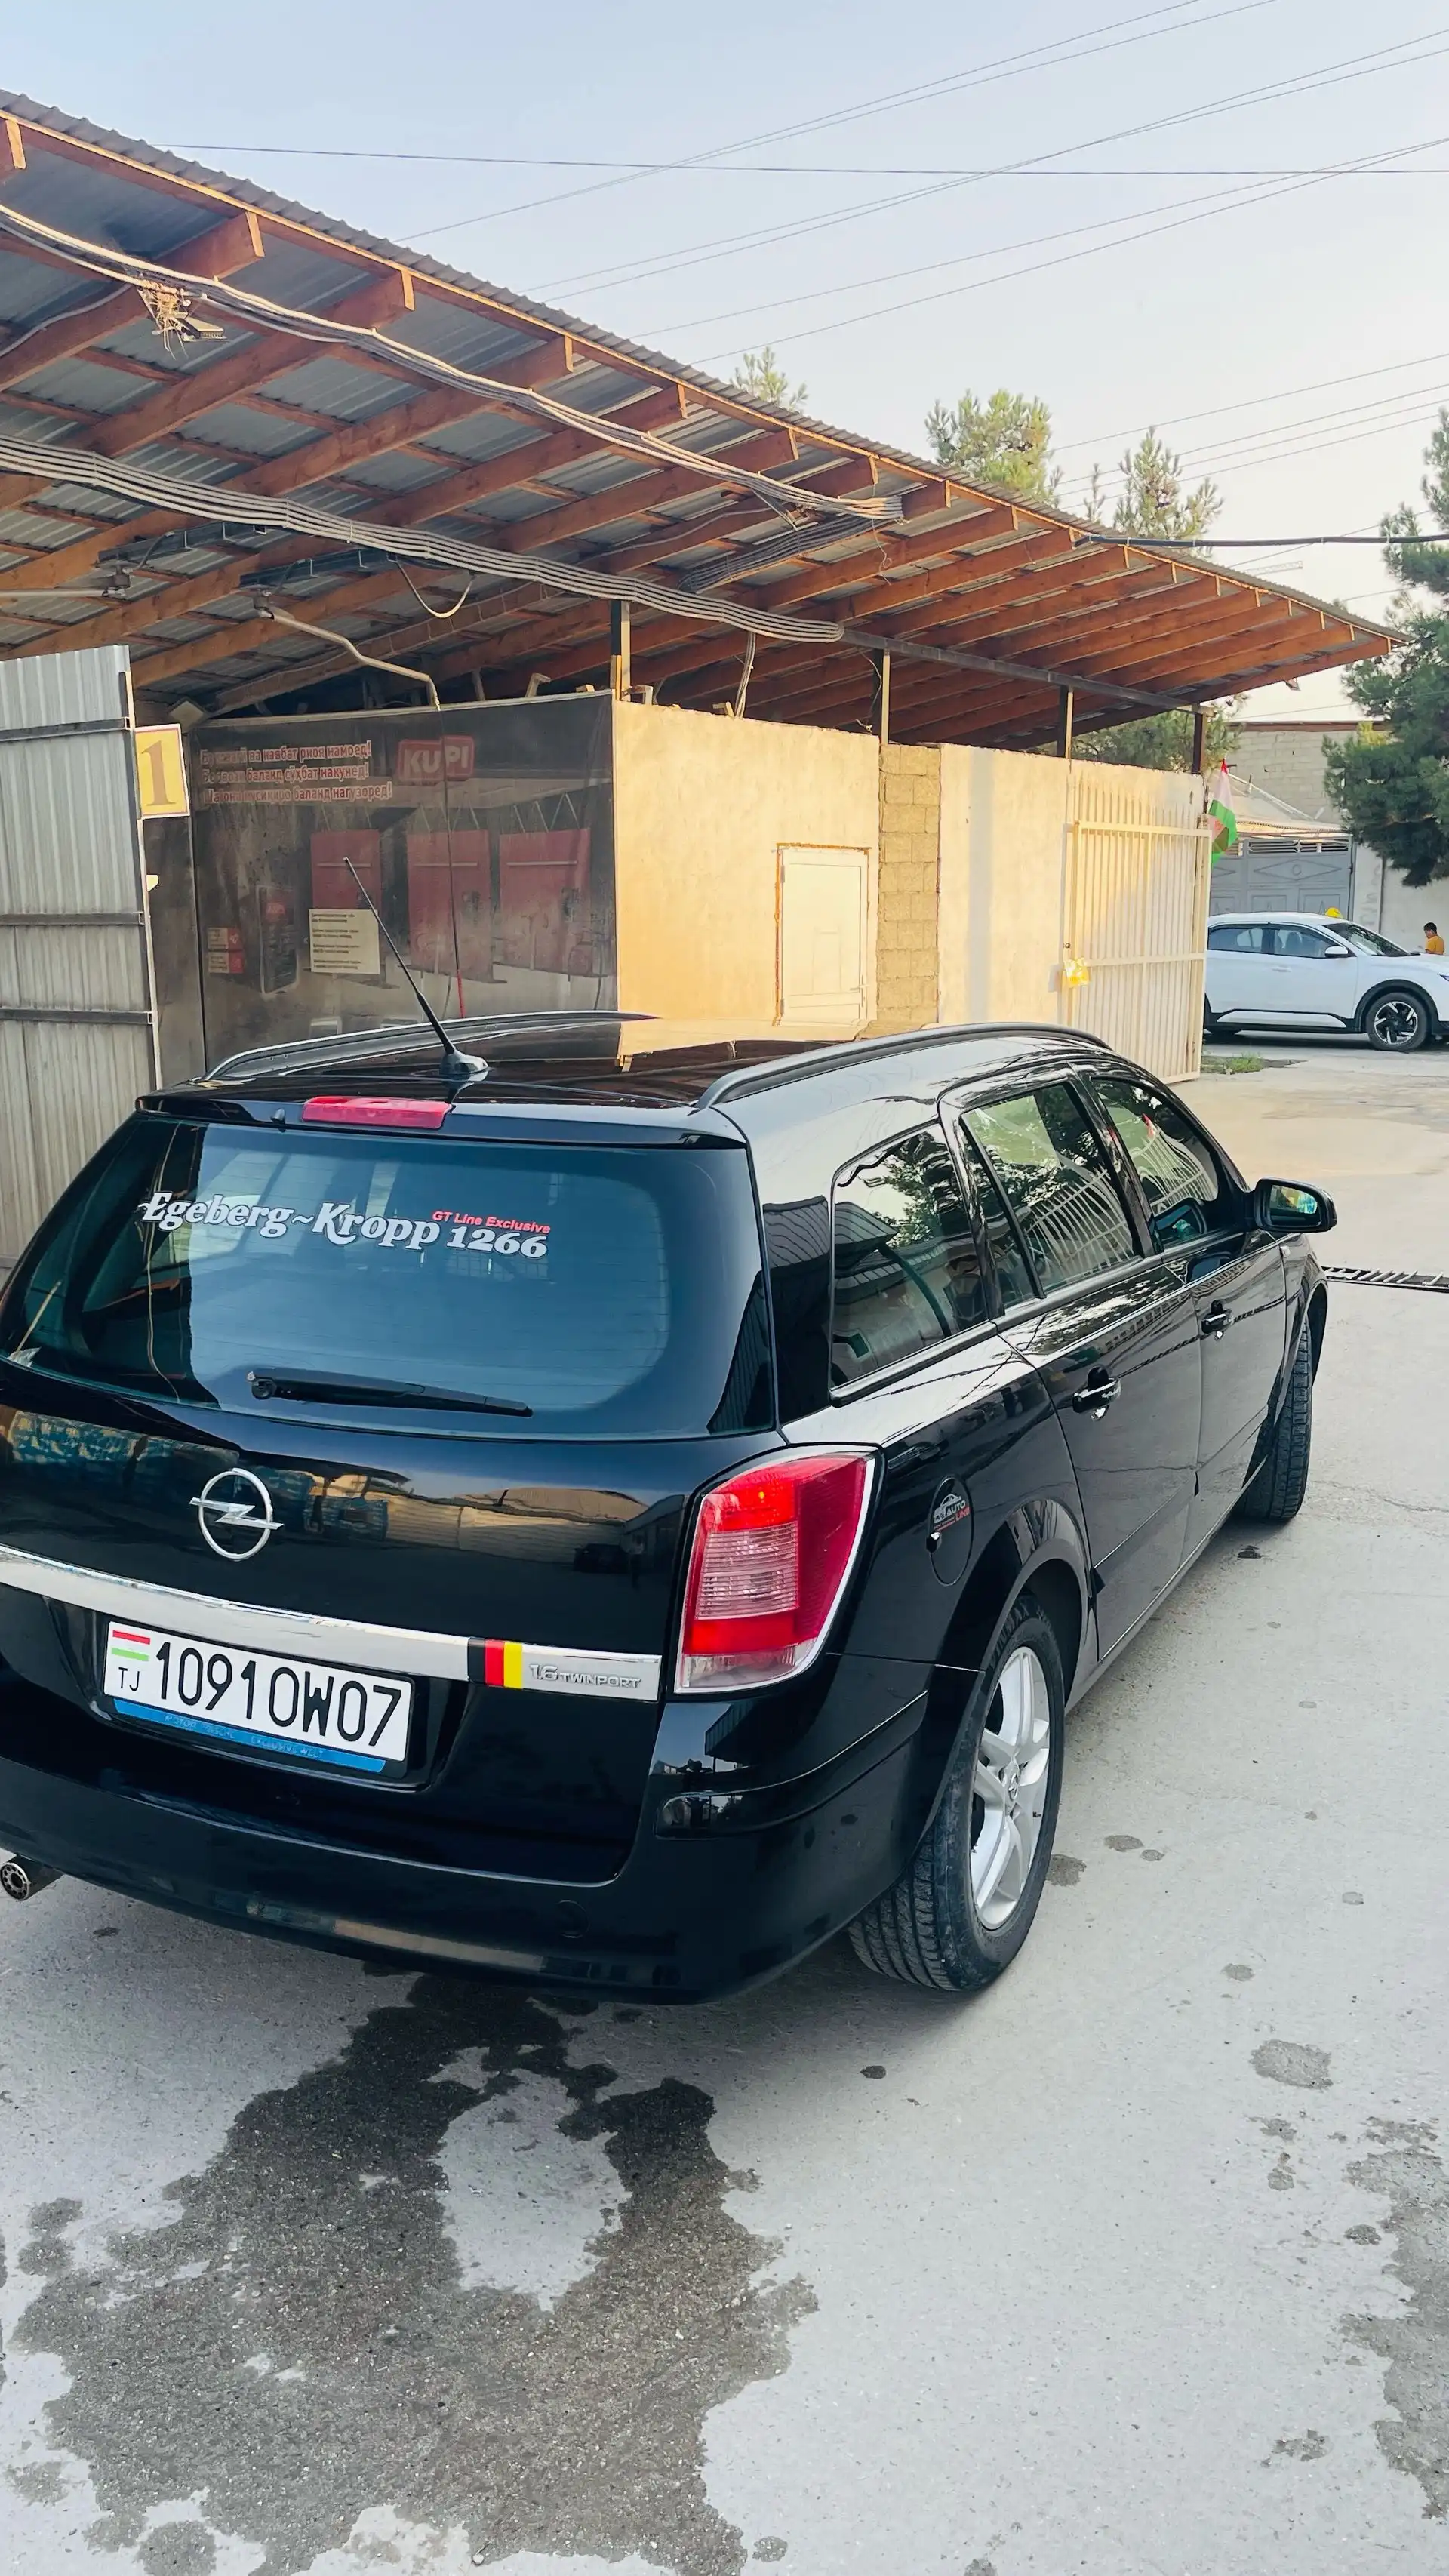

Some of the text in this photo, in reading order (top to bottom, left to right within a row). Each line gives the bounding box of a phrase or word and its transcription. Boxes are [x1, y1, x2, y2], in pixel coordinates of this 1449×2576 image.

[327, 740, 371, 759] намоед!
[140, 740, 177, 806] 1
[432, 1210, 551, 1234] GT Line Exclusive
[446, 1226, 548, 1258] 1266
[118, 1667, 140, 1692] TJ
[558, 1672, 641, 1689] TWINPORT
